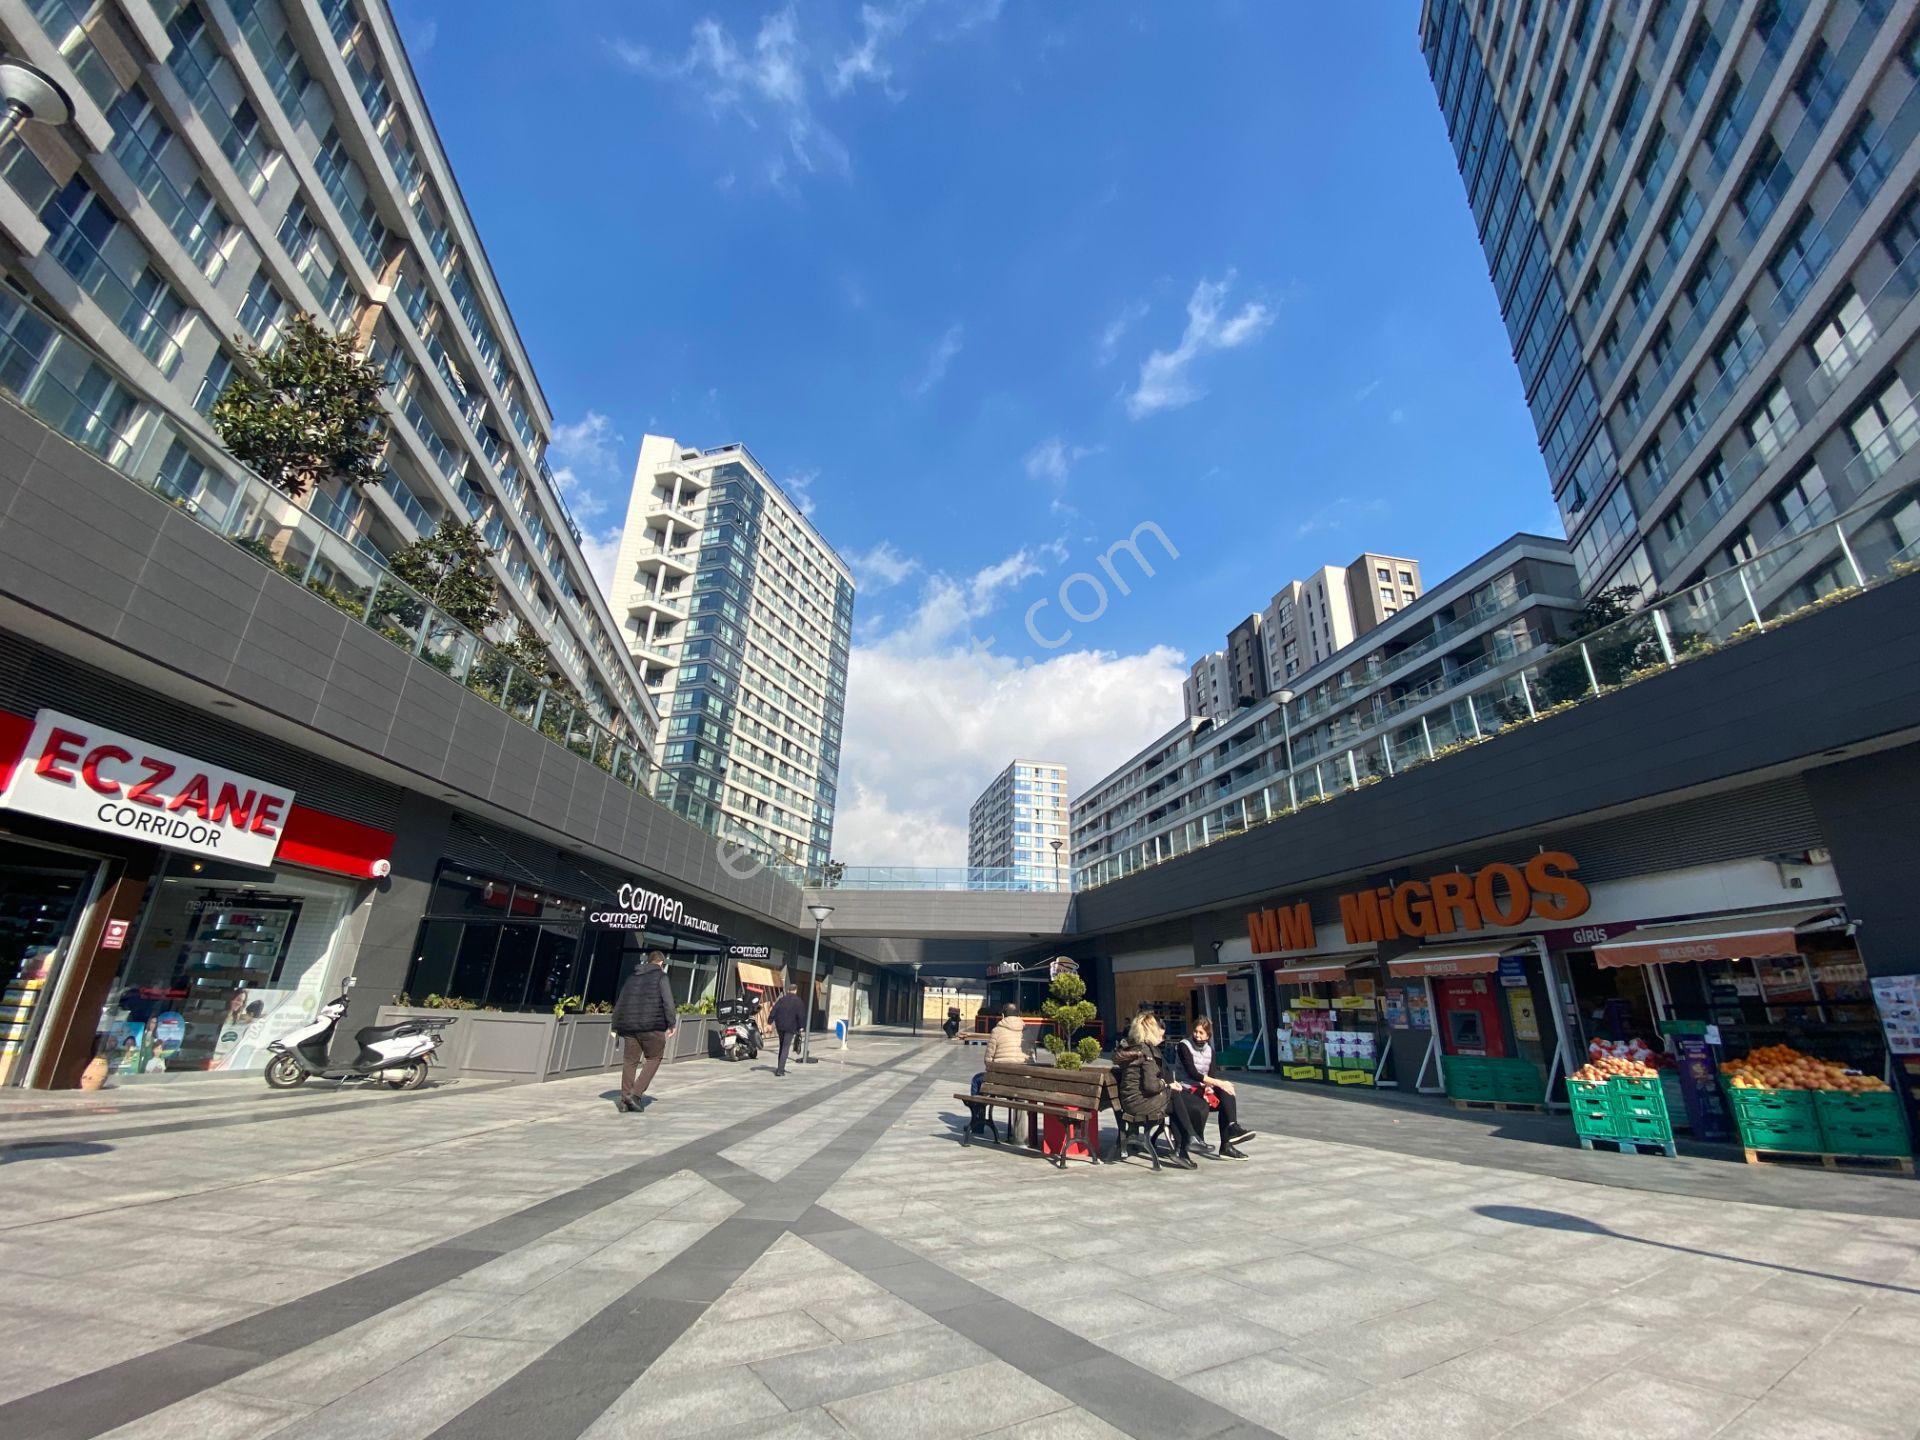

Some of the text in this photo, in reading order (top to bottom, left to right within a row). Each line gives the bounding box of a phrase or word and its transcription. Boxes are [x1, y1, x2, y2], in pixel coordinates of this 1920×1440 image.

[34, 727, 286, 837] ECZANE
[97, 803, 222, 848] CORRIDOR
[590, 911, 648, 925] carmen
[617, 883, 683, 925] carmen
[683, 915, 720, 935] TATLICILIK
[1247, 902, 1318, 955] MM
[730, 945, 769, 954] carmen
